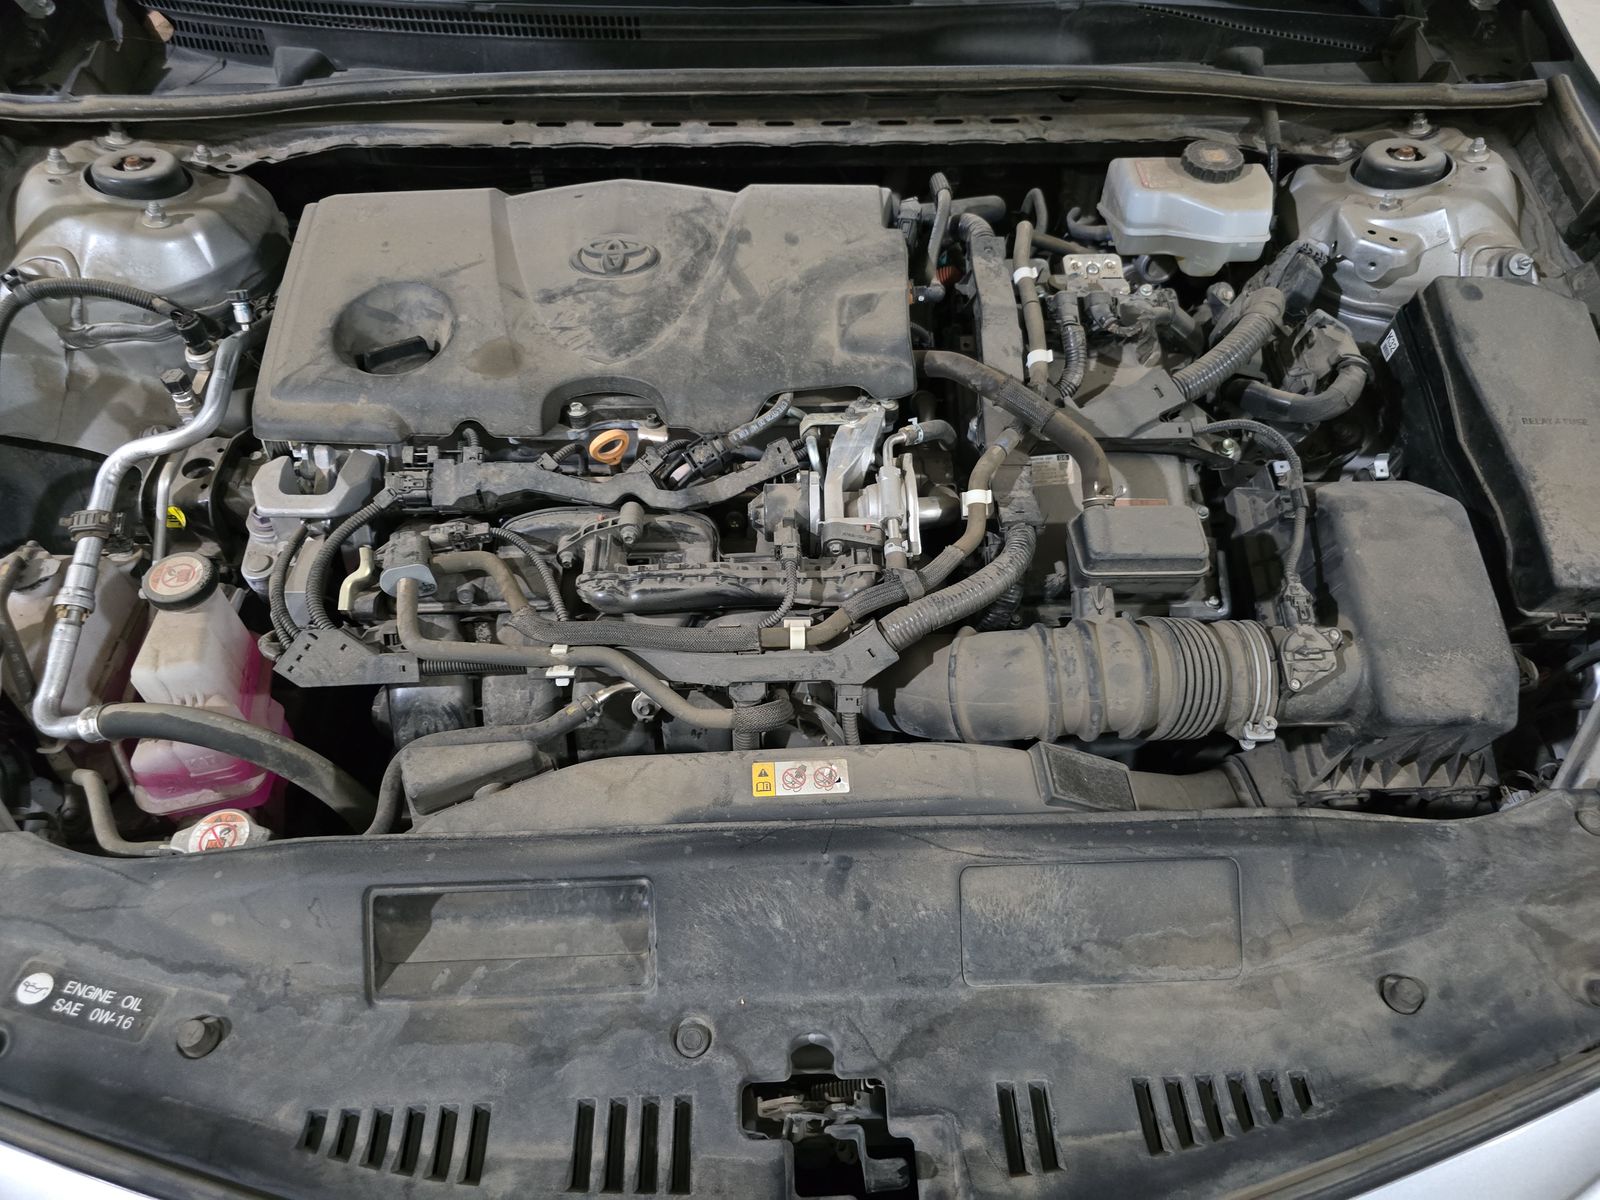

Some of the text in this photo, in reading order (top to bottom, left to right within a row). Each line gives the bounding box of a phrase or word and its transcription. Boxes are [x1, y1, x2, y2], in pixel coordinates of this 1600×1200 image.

[63, 980, 143, 1012] ENGINE OIL
[52, 998, 135, 1030] SAE 0W-16
